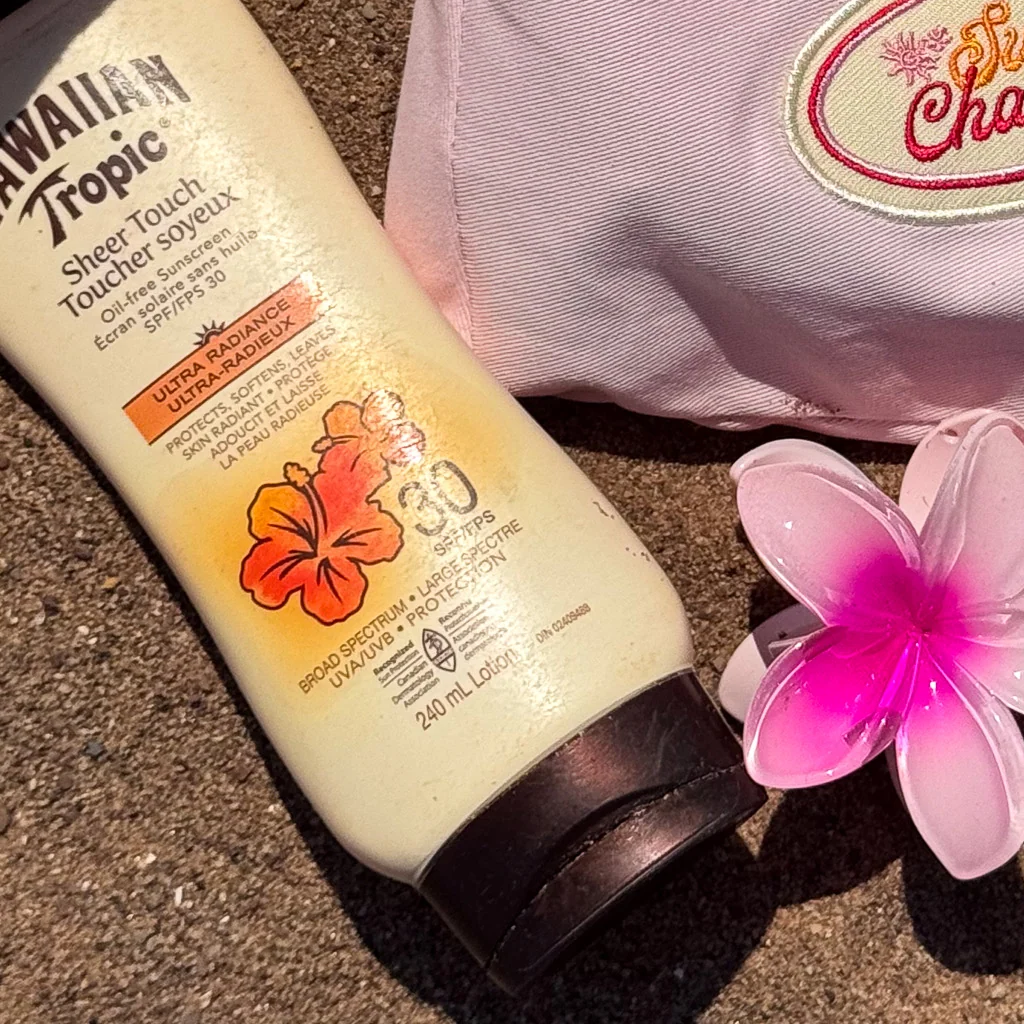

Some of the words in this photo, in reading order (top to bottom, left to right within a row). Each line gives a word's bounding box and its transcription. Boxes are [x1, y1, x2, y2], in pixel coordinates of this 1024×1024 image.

[0, 55, 191, 225] AWAIIAN
[18, 130, 168, 249] Tropic
[61, 228, 129, 286] Sheer
[125, 177, 206, 234] Touch
[57, 243, 155, 318] Toucher
[156, 186, 241, 251] soyeux
[101, 280, 157, 324] Oil-free
[157, 227, 232, 282] Sunscreen
[93, 319, 137, 351] Écran
[138, 281, 185, 319] solaire
[186, 258, 220, 283] sans
[144, 285, 205, 334] SPF/FPS
[204, 269, 227, 290] 30
[152, 361, 206, 404] ULTRA
[205, 298, 292, 364] RADIANCE
[165, 401, 232, 454] PROTECTS,
[230, 358, 291, 405] SOFTENS,
[289, 323, 337, 363] LEAVES
[167, 315, 296, 414] ULTRA-RADIEUX
[182, 432, 212, 462] SKIN
[213, 392, 268, 440] RADIANT
[210, 409, 266, 459] ADOUCIT
[264, 400, 281, 417] ET
[282, 370, 325, 406] LAISSE
[219, 453, 239, 471] LA
[237, 428, 271, 456] PEAU
[273, 383, 331, 432] RADIEUSE
[398, 459, 478, 537] 30
[298, 653, 341, 695] BROAD
[339, 598, 409, 658] SPECTRUM
[416, 558, 462, 598] LARGE
[461, 518, 524, 568] SPECTRE
[329, 630, 395, 689] UVA/UVB
[415, 698, 447, 731] 240
[445, 681, 473, 708] mL
[467, 648, 519, 689] Lotion
